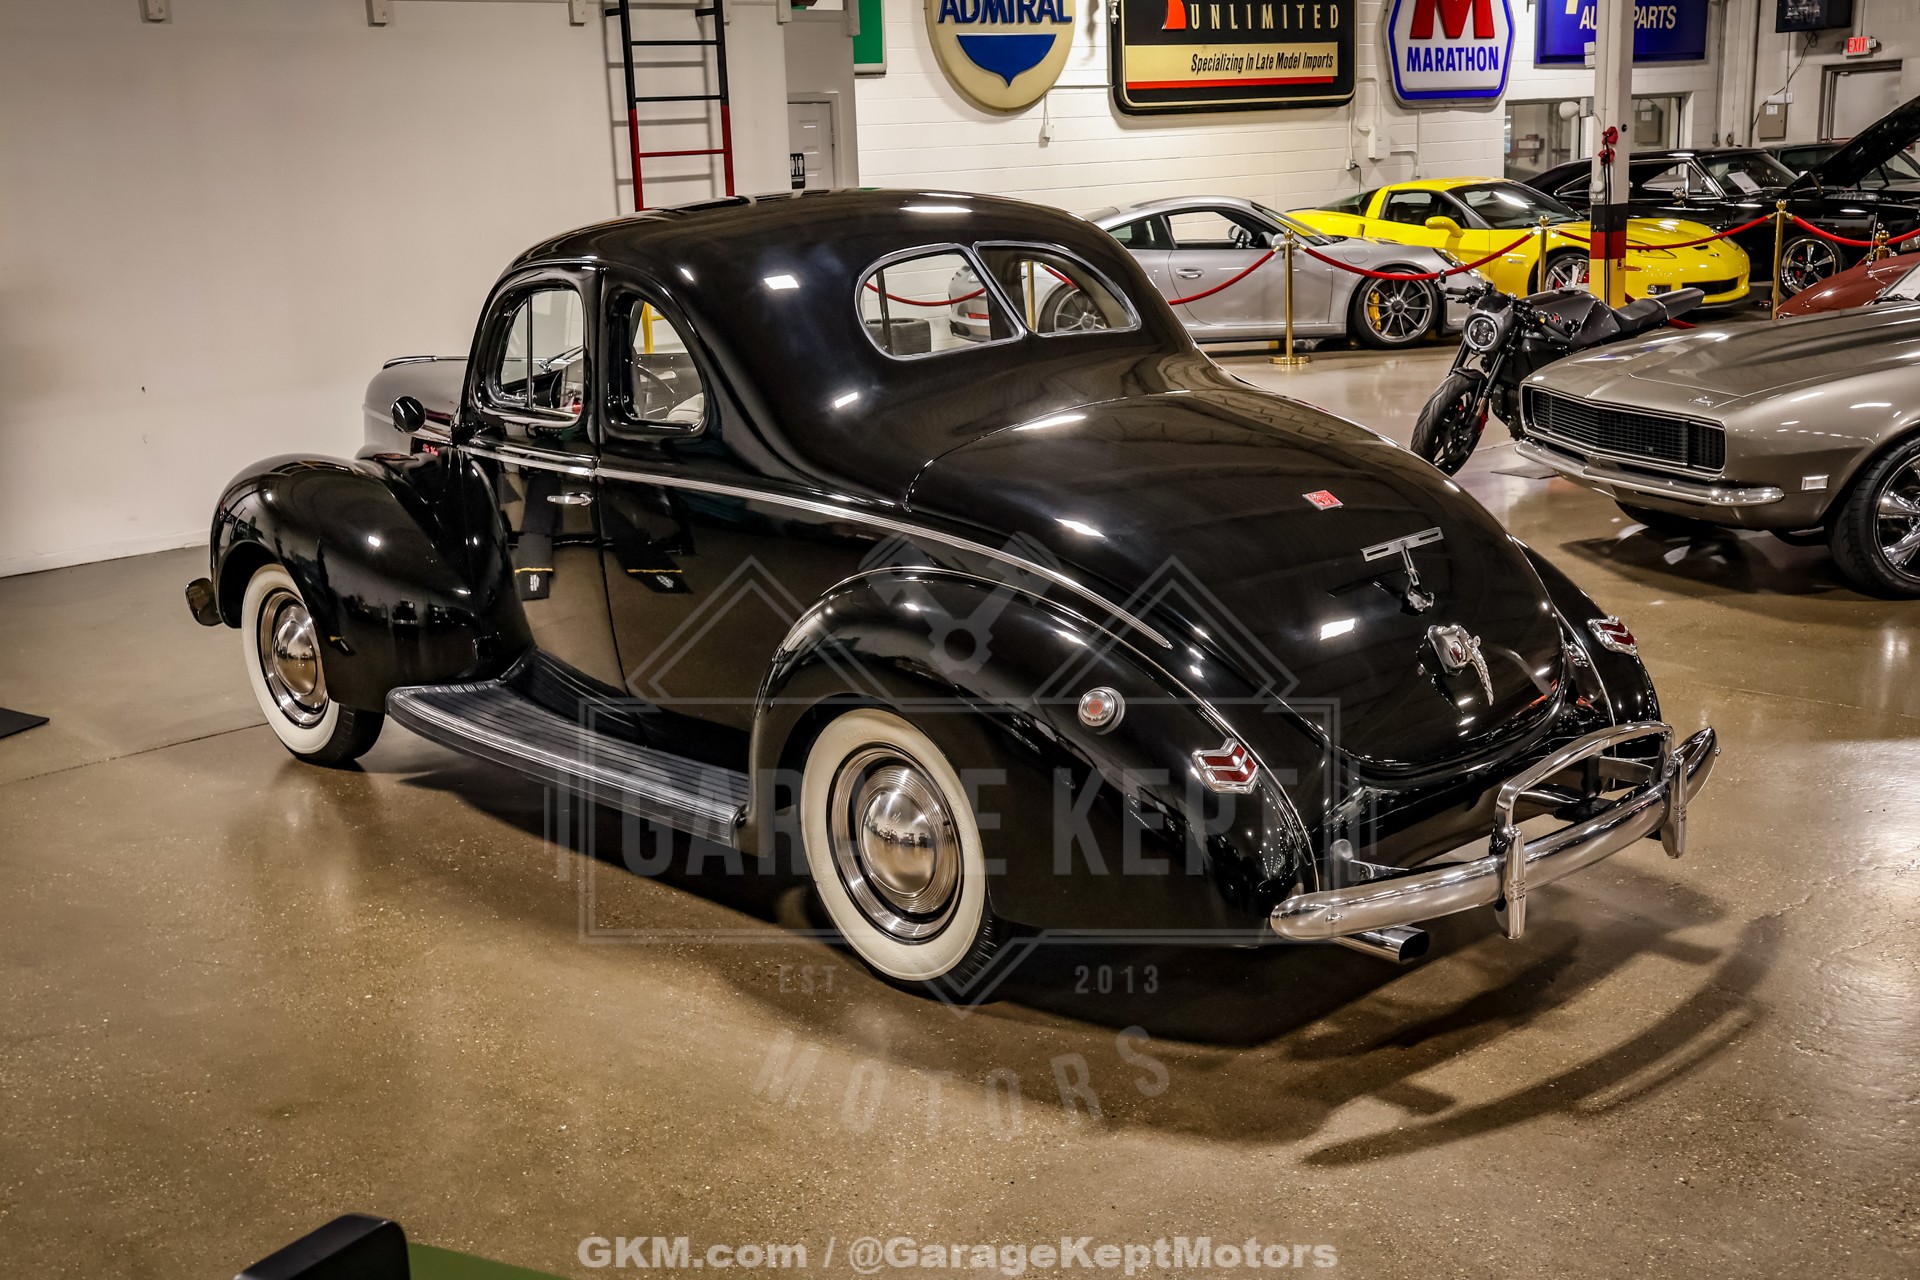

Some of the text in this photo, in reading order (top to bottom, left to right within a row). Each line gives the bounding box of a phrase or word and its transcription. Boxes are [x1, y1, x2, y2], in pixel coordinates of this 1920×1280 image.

[937, 0, 1073, 24] ADMIRAL
[1190, 4, 1340, 30] UNLIMITED
[1634, 5, 1677, 29] PARTS
[1848, 37, 1868, 53] EXIT
[1191, 52, 1334, 74] Specializing In Late Model Imports
[1406, 46, 1499, 72] MARATHON
